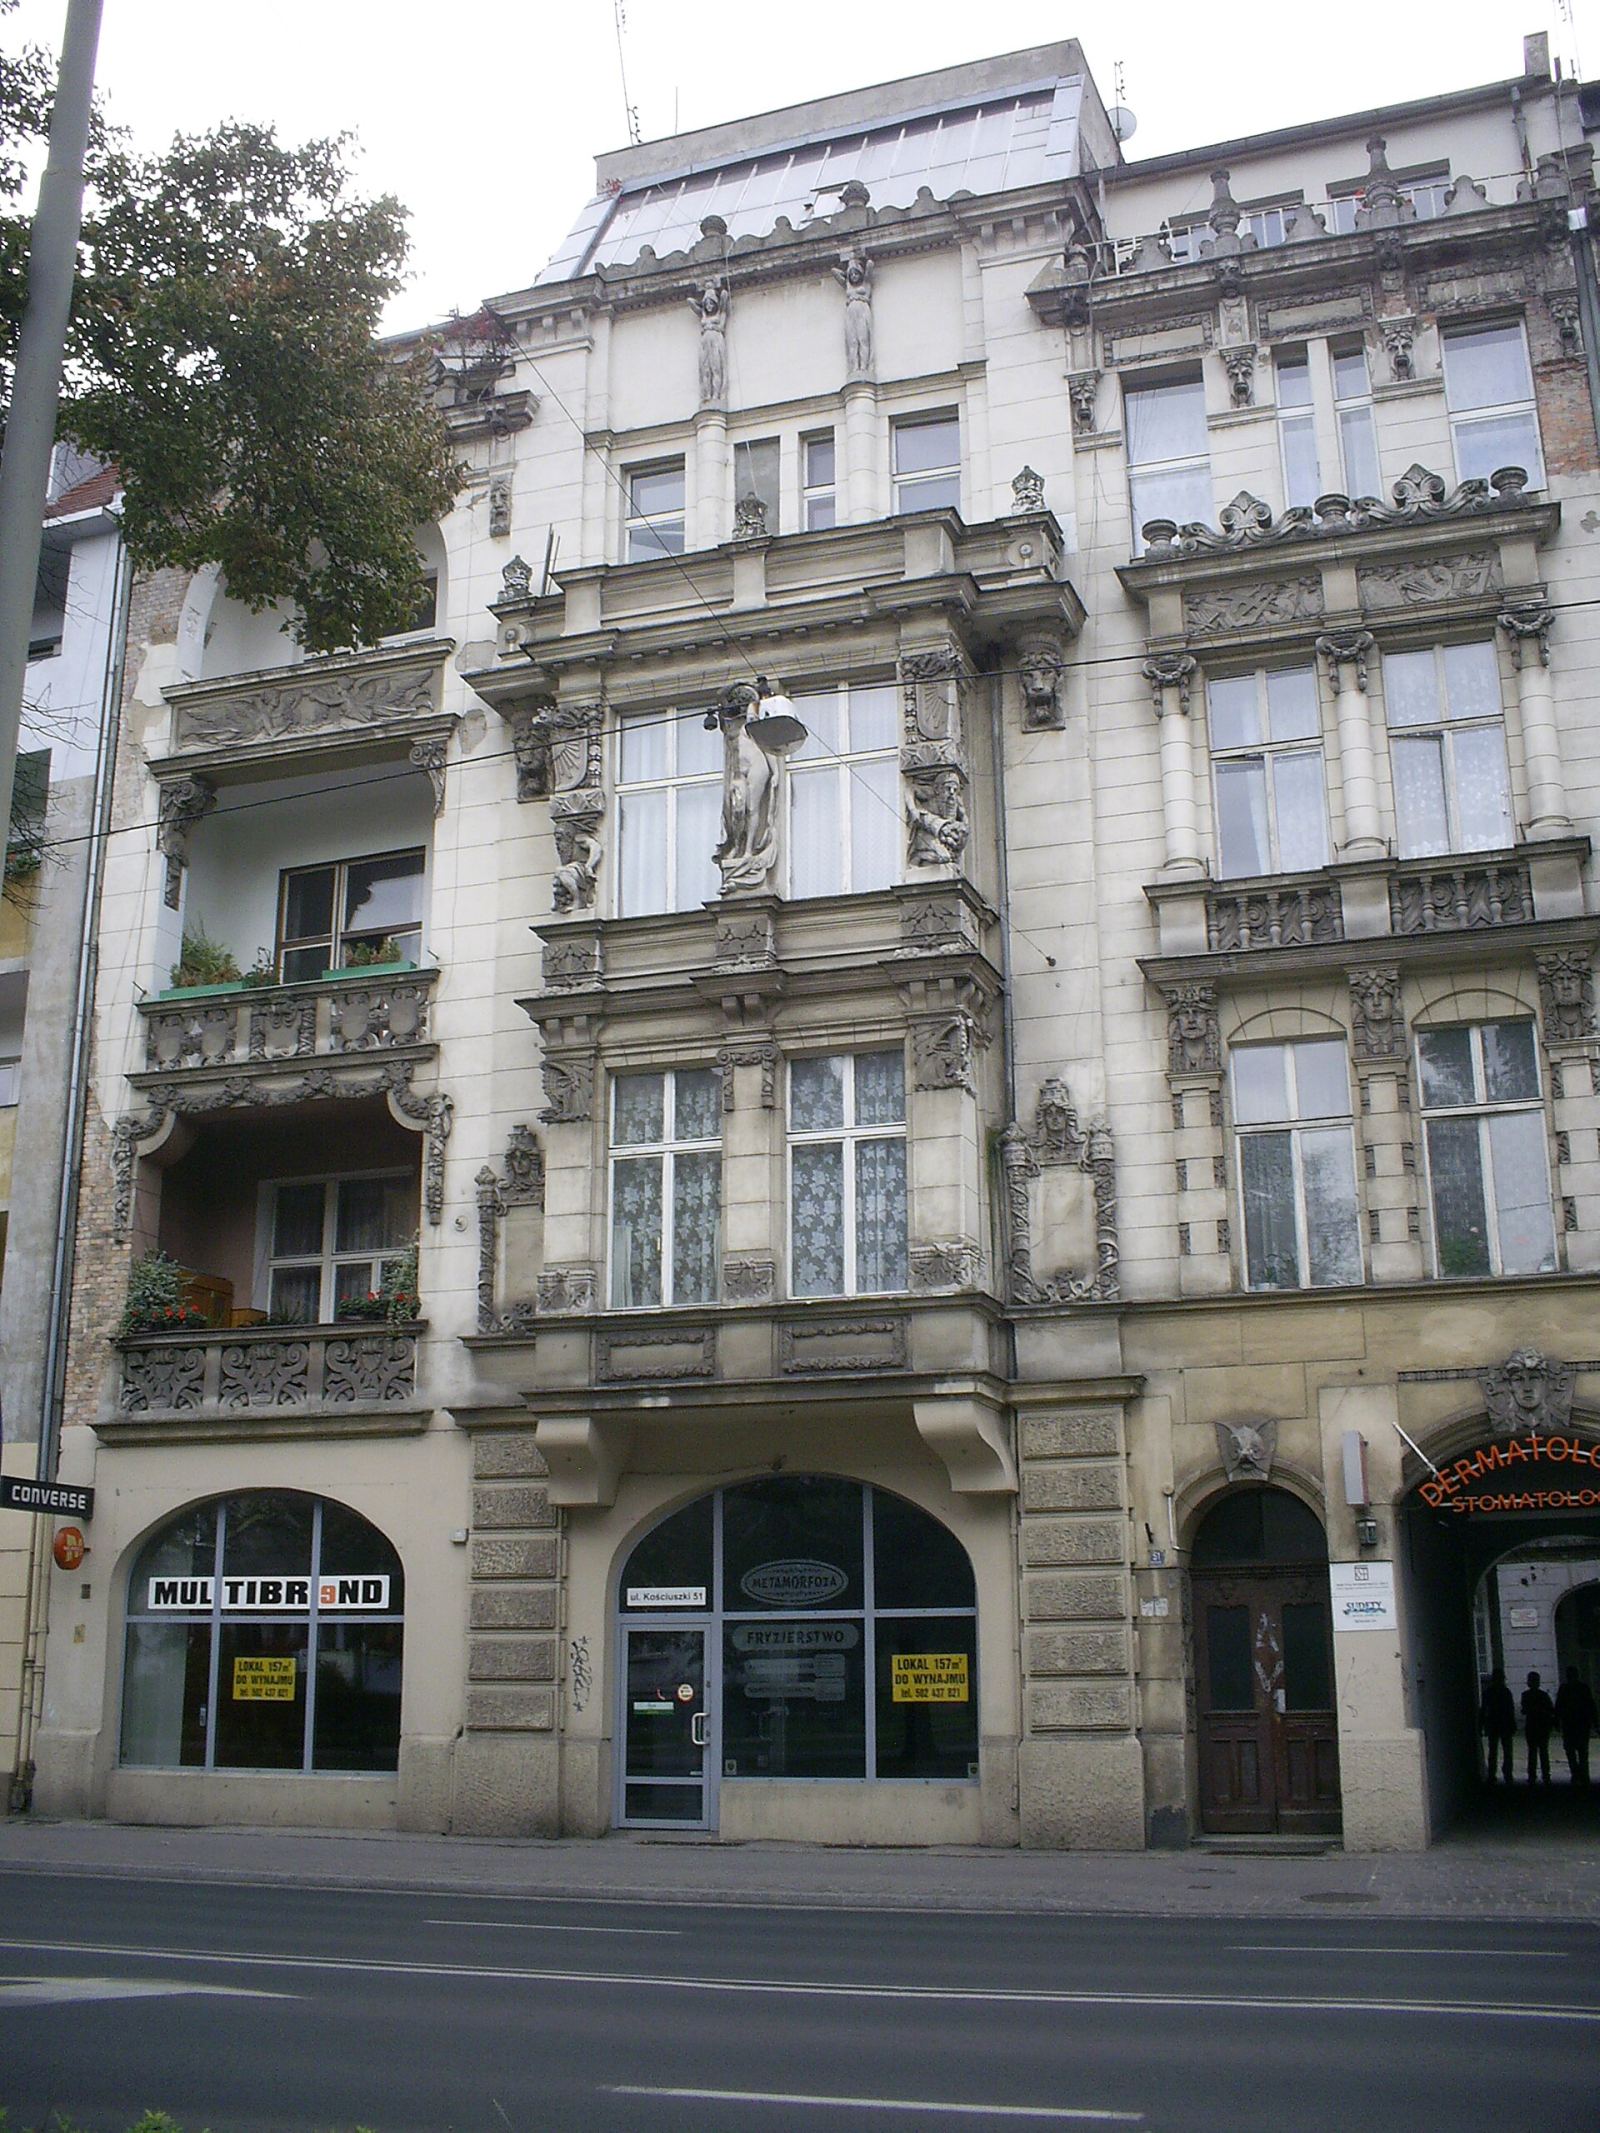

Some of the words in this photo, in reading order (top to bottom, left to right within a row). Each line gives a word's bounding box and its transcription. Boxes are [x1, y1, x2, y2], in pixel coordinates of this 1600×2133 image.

[11, 1485, 86, 1510] CONVERSE
[1453, 1489, 1600, 1513] STOMATOLO
[643, 1592, 691, 1601] Kościuszki
[693, 1592, 703, 1600] 51
[239, 1661, 264, 1672] LOKAL
[897, 1658, 928, 1670] LOKAL
[236, 1675, 247, 1684] DO
[251, 1674, 293, 1685] WYNAJMU
[895, 1674, 908, 1684] DO
[913, 1673, 965, 1684] WYNAJMU
